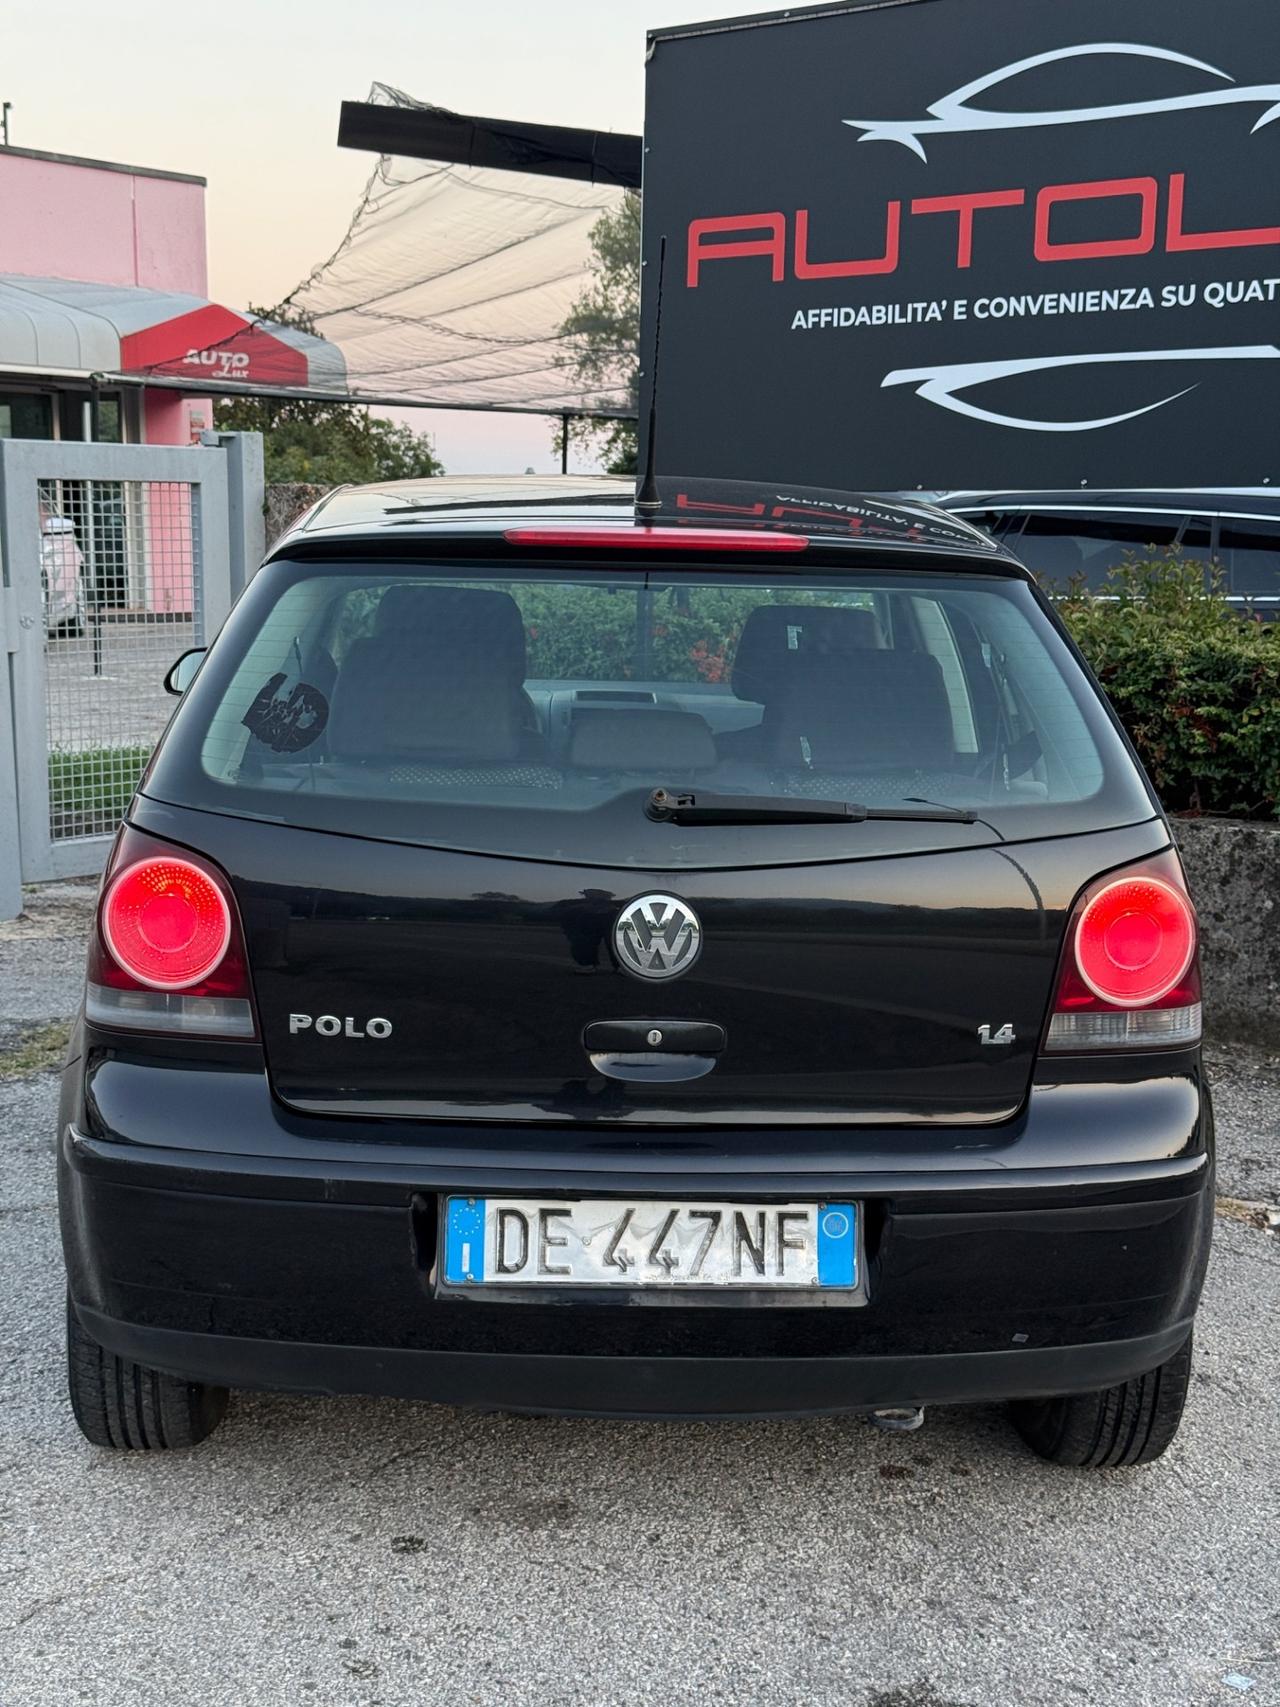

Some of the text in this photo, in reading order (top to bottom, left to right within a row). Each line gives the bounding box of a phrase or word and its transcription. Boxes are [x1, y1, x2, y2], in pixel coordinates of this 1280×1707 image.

[953, 300, 967, 321] E
[973, 287, 1154, 319] CONVENIENZA
[1160, 283, 1196, 308] SU
[1203, 278, 1280, 308] QUAT
[182, 348, 250, 368] AUTO
[288, 1013, 393, 1039] POLO
